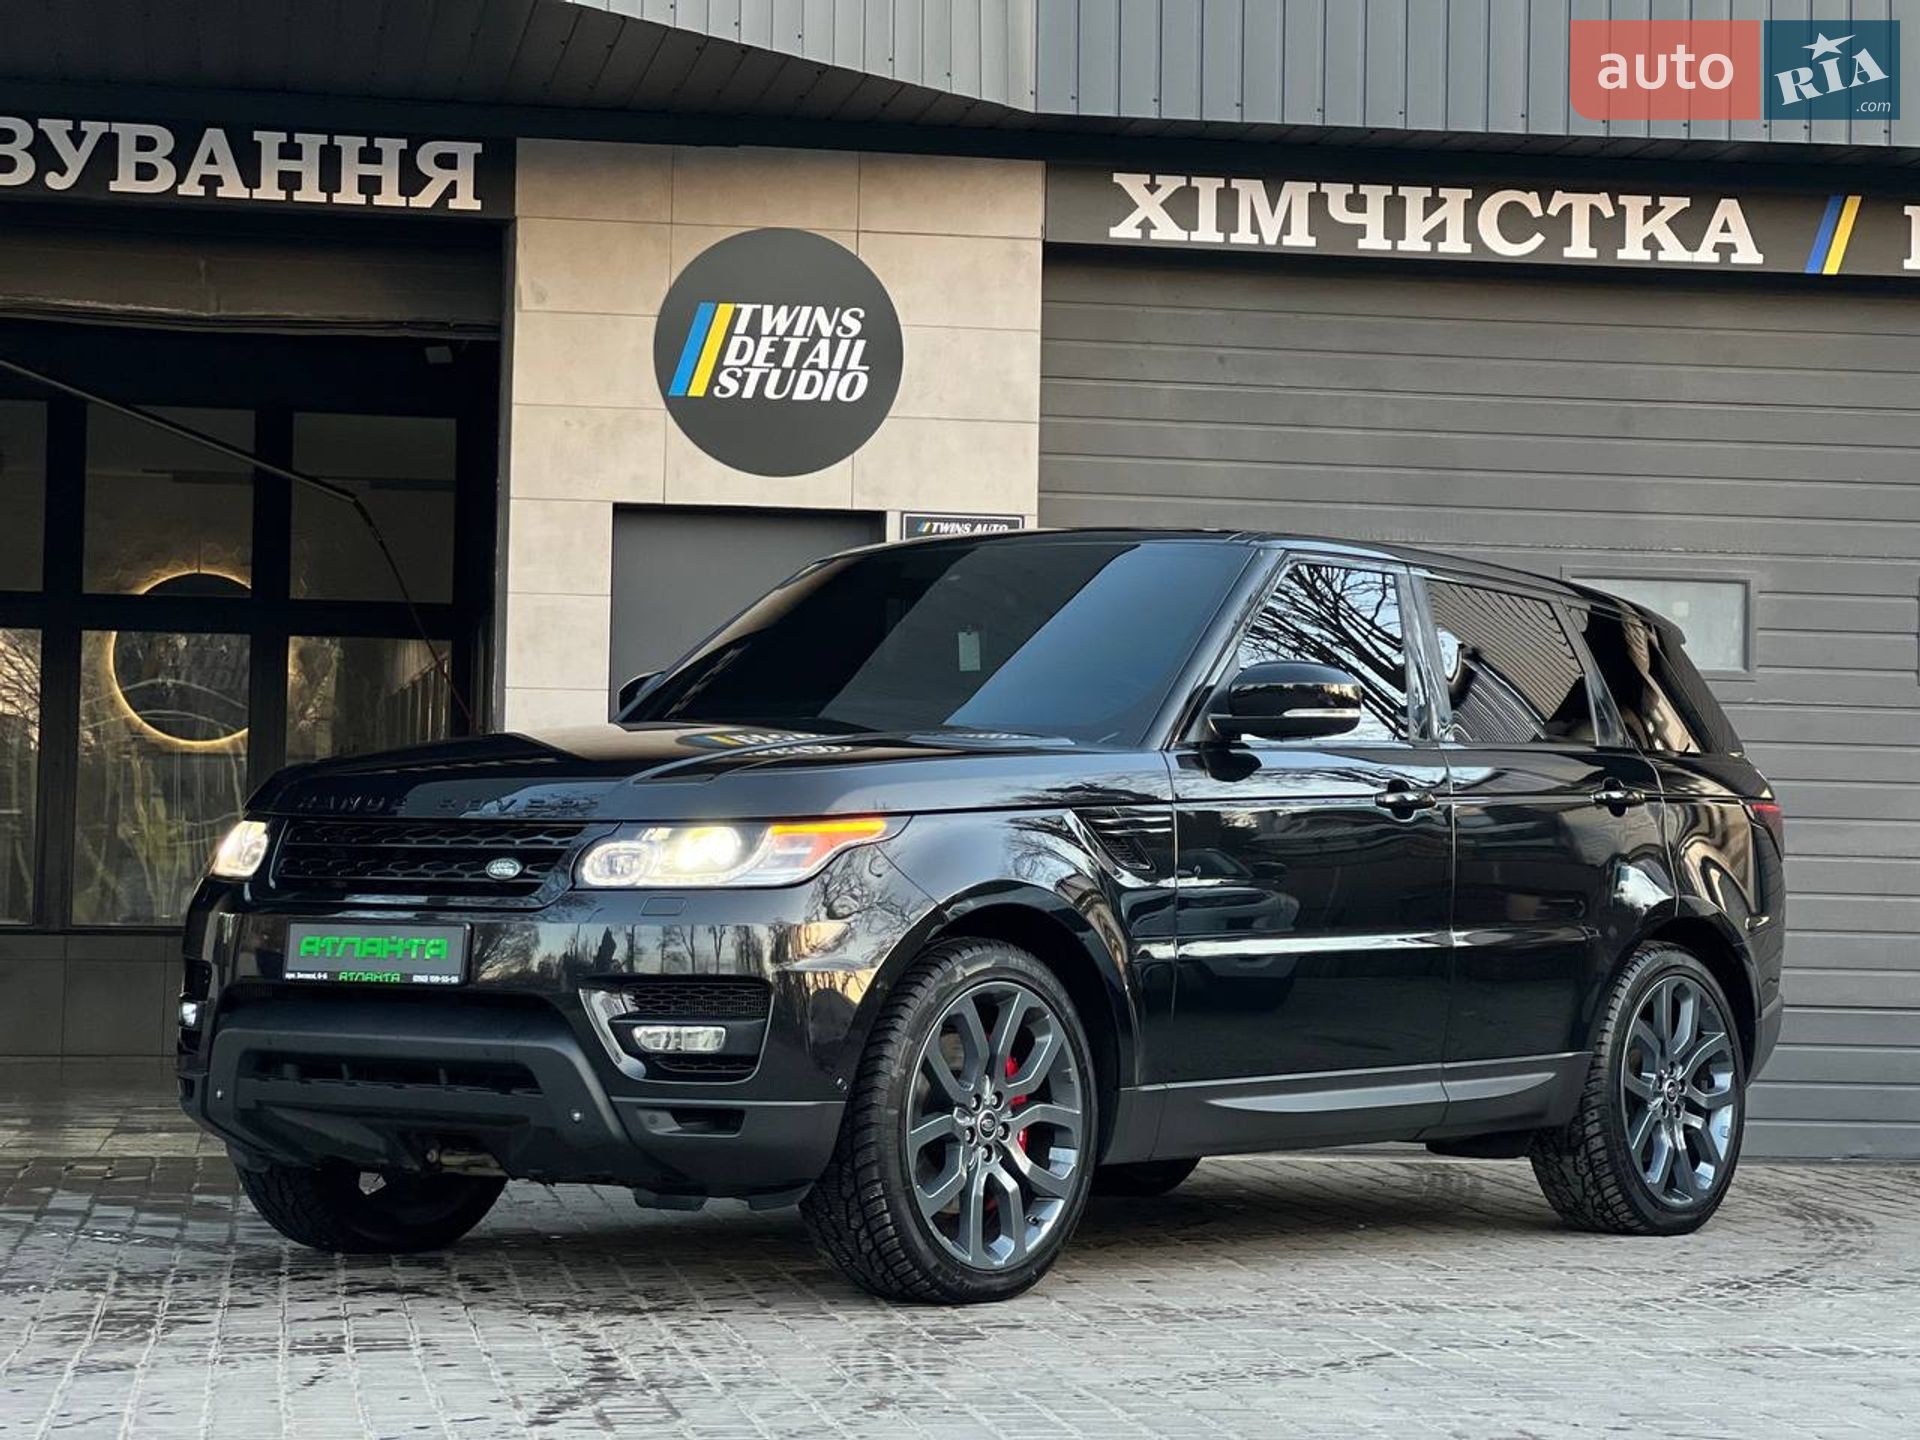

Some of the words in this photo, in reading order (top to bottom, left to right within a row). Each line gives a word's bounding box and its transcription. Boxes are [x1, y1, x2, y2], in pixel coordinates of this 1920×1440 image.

[1108, 172, 1764, 265] ХІМЧИСТКА
[733, 303, 866, 339] TWINS
[722, 335, 870, 371] DETAIL
[713, 366, 869, 402] STUDIO
[931, 521, 972, 534] TWINS
